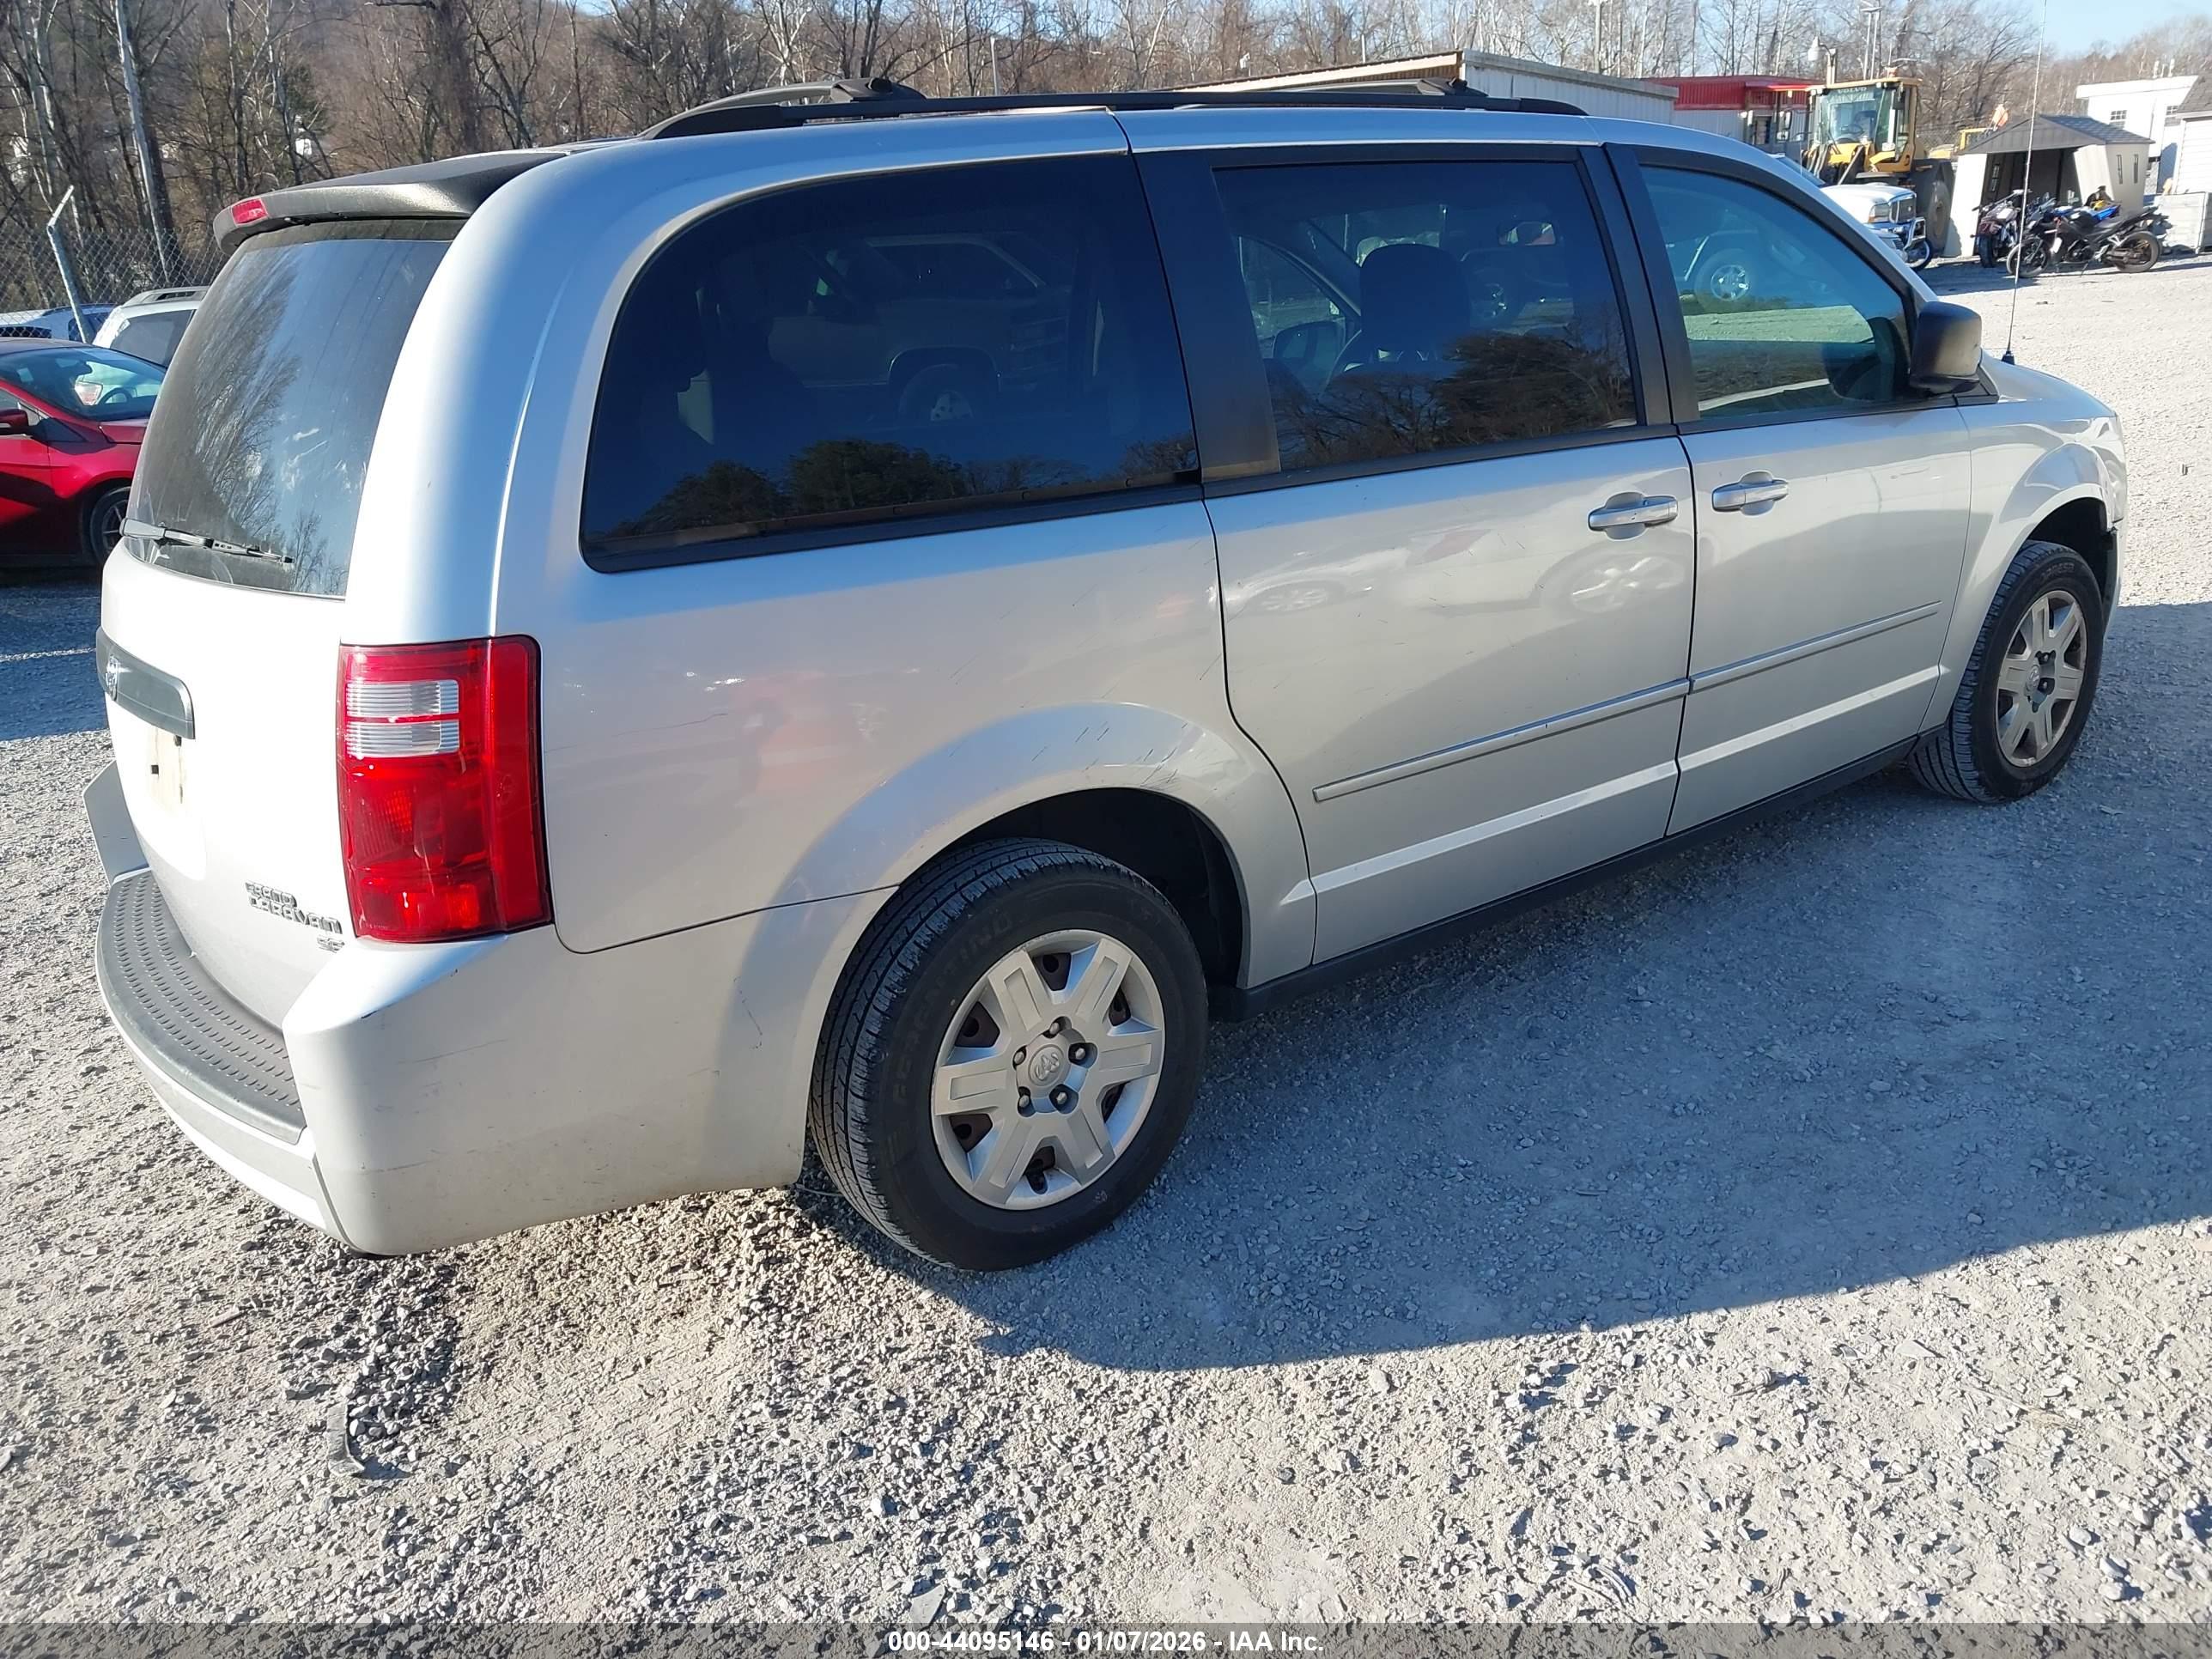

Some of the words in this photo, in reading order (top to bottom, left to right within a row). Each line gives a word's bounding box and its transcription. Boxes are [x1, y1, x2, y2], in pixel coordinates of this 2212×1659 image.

[245, 880, 298, 908] GRAND
[249, 895, 343, 935] CARAVAN
[316, 935, 345, 953] SE
